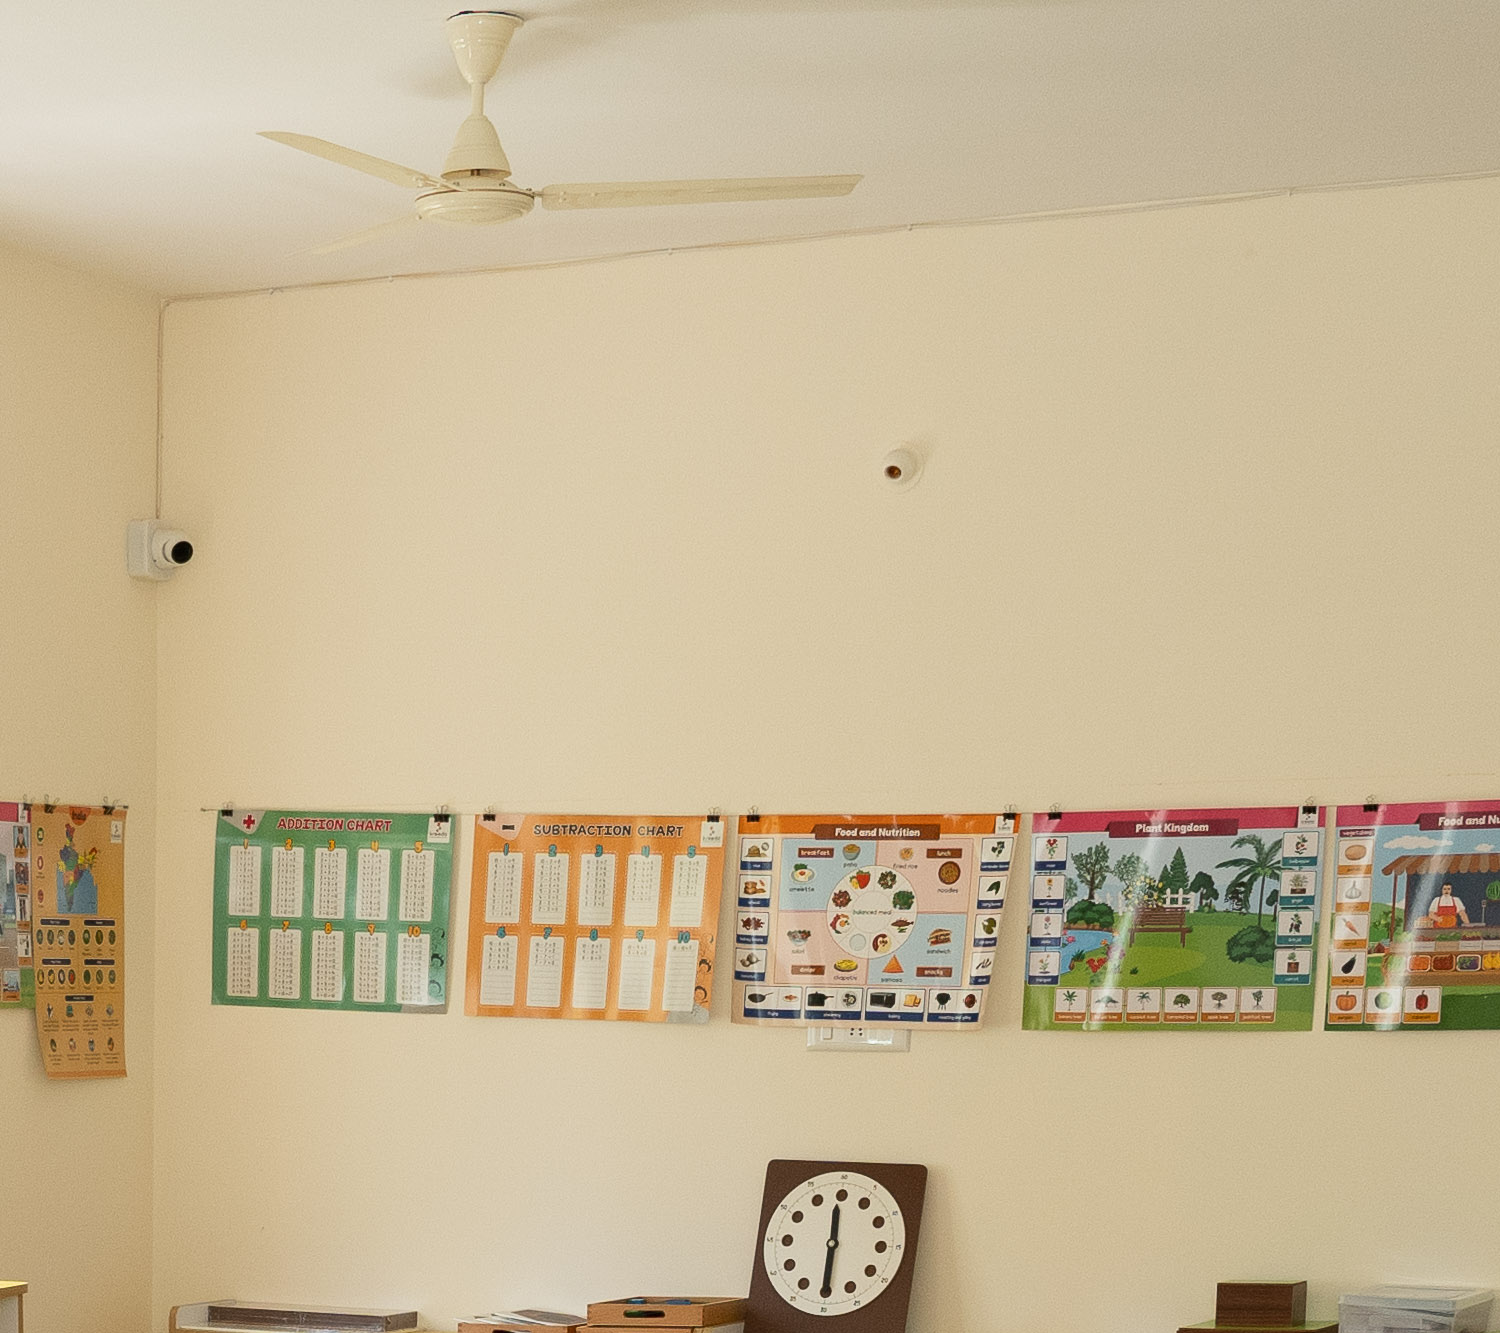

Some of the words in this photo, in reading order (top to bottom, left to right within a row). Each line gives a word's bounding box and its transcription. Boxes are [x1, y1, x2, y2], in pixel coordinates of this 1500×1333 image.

[277, 818, 343, 831] ADDITION
[346, 819, 392, 832] CHART
[1437, 815, 1464, 827] Food
[1465, 815, 1486, 826] and
[533, 824, 632, 836] SUBTRACTION
[637, 825, 684, 838] CHART
[835, 827, 857, 837] Food
[858, 827, 877, 837] and
[878, 828, 920, 838] Nutrition
[1135, 822, 1162, 834] Plant
[1163, 822, 1209, 834] Kingdom
[243, 838, 248, 850] 1
[284, 838, 293, 851] 2
[327, 839, 335, 851] 3
[414, 841, 424, 853] 5
[503, 843, 509, 856] 1
[548, 844, 558, 857] 2
[594, 844, 603, 857] 3
[687, 845, 697, 858] 5
[800, 848, 831, 858] breakfast
[240, 919, 248, 931] 6
[282, 920, 290, 932] 7
[324, 922, 333, 934] 8
[367, 923, 376, 935] 9
[408, 925, 421, 937] 10
[496, 926, 506, 938] 6
[543, 926, 552, 939] 7
[589, 929, 598, 941] 8
[635, 929, 644, 941] 9
[677, 931, 690, 943] 10
